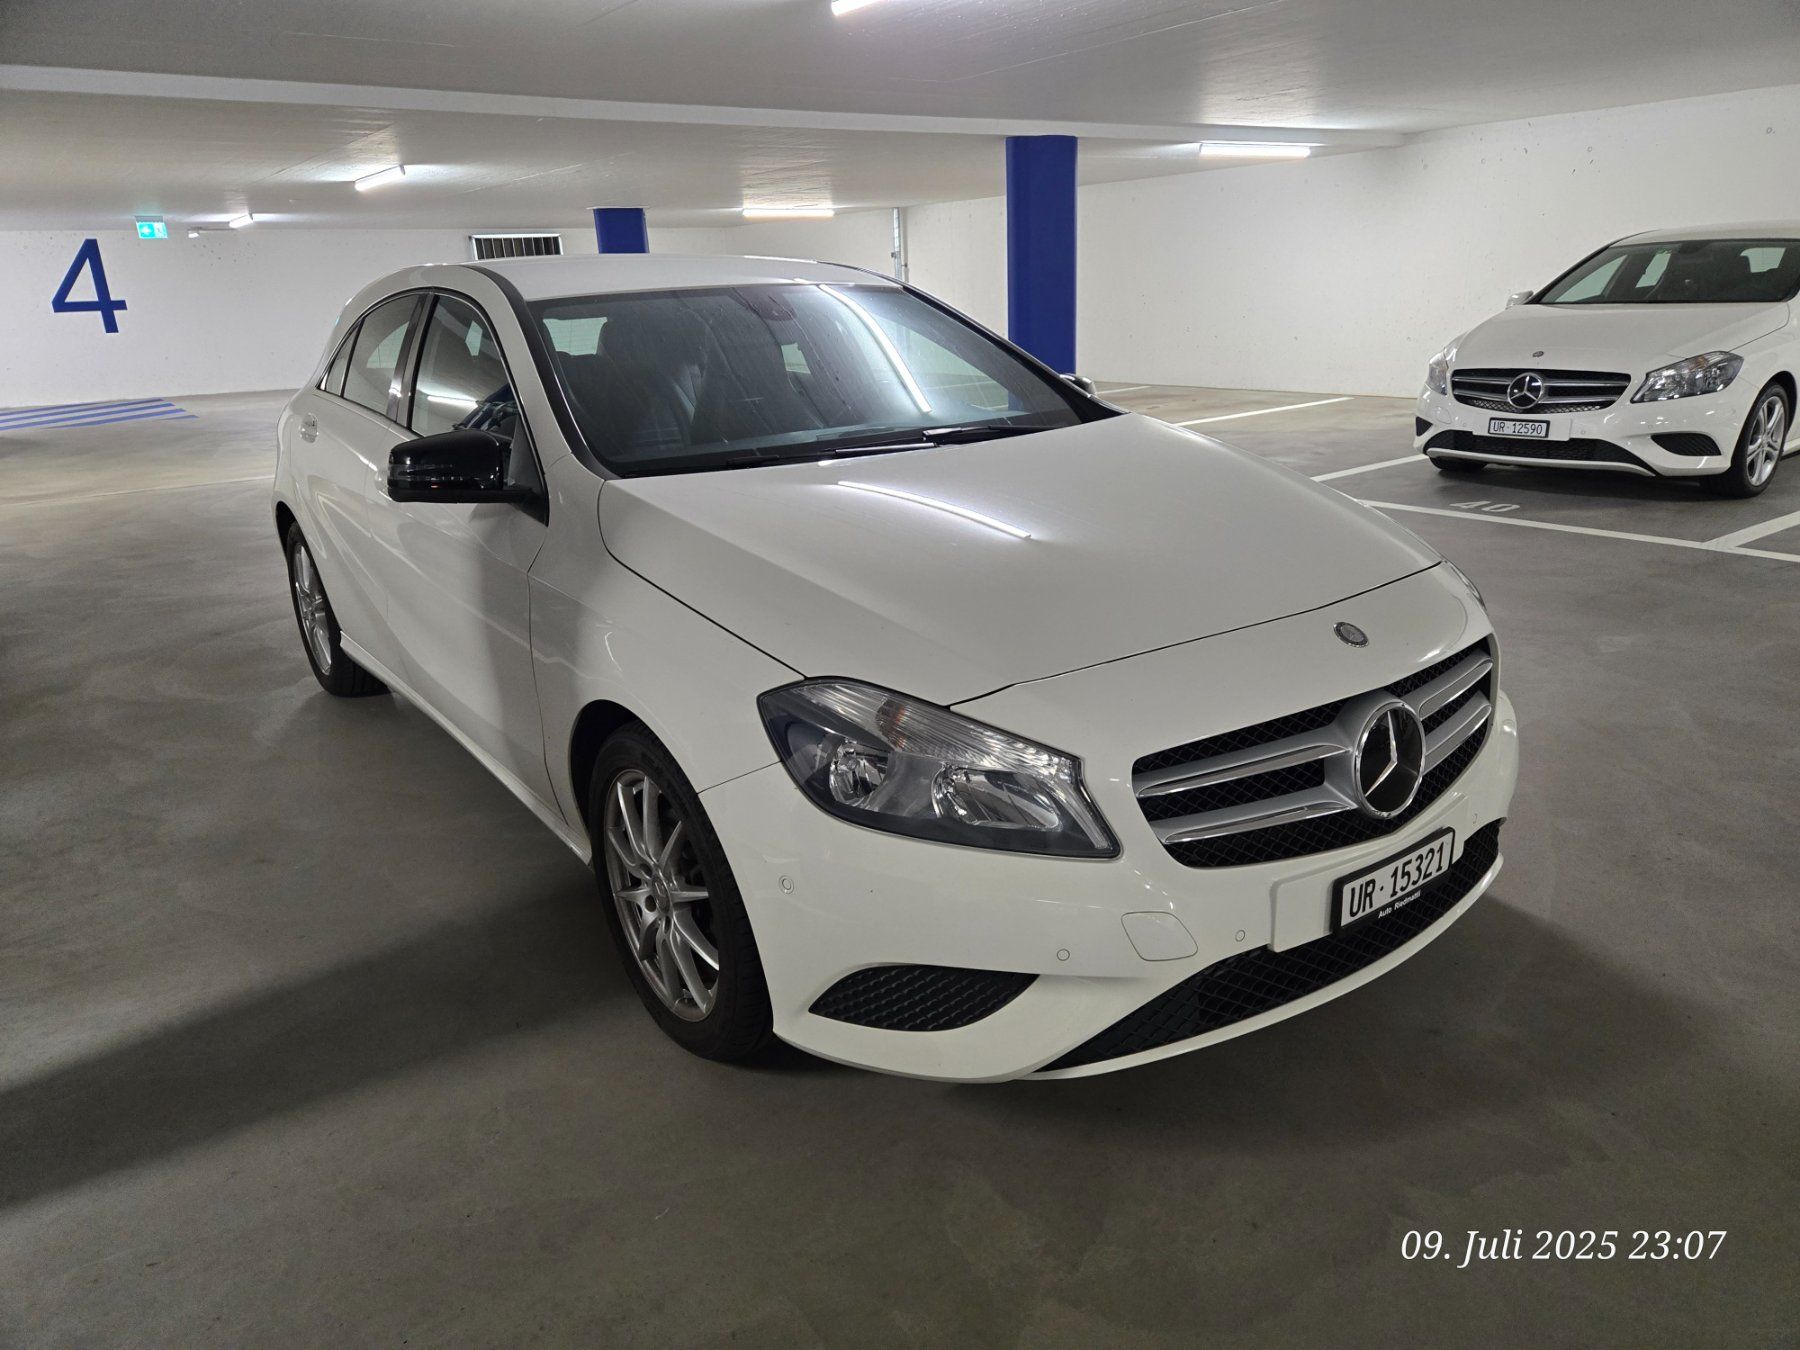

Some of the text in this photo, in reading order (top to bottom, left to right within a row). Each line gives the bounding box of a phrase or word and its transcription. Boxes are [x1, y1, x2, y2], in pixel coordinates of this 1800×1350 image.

[51, 238, 128, 333] 4
[1493, 421, 1543, 435] UR 12590
[1449, 500, 1521, 512] 40
[1349, 841, 1445, 917] UR 15321
